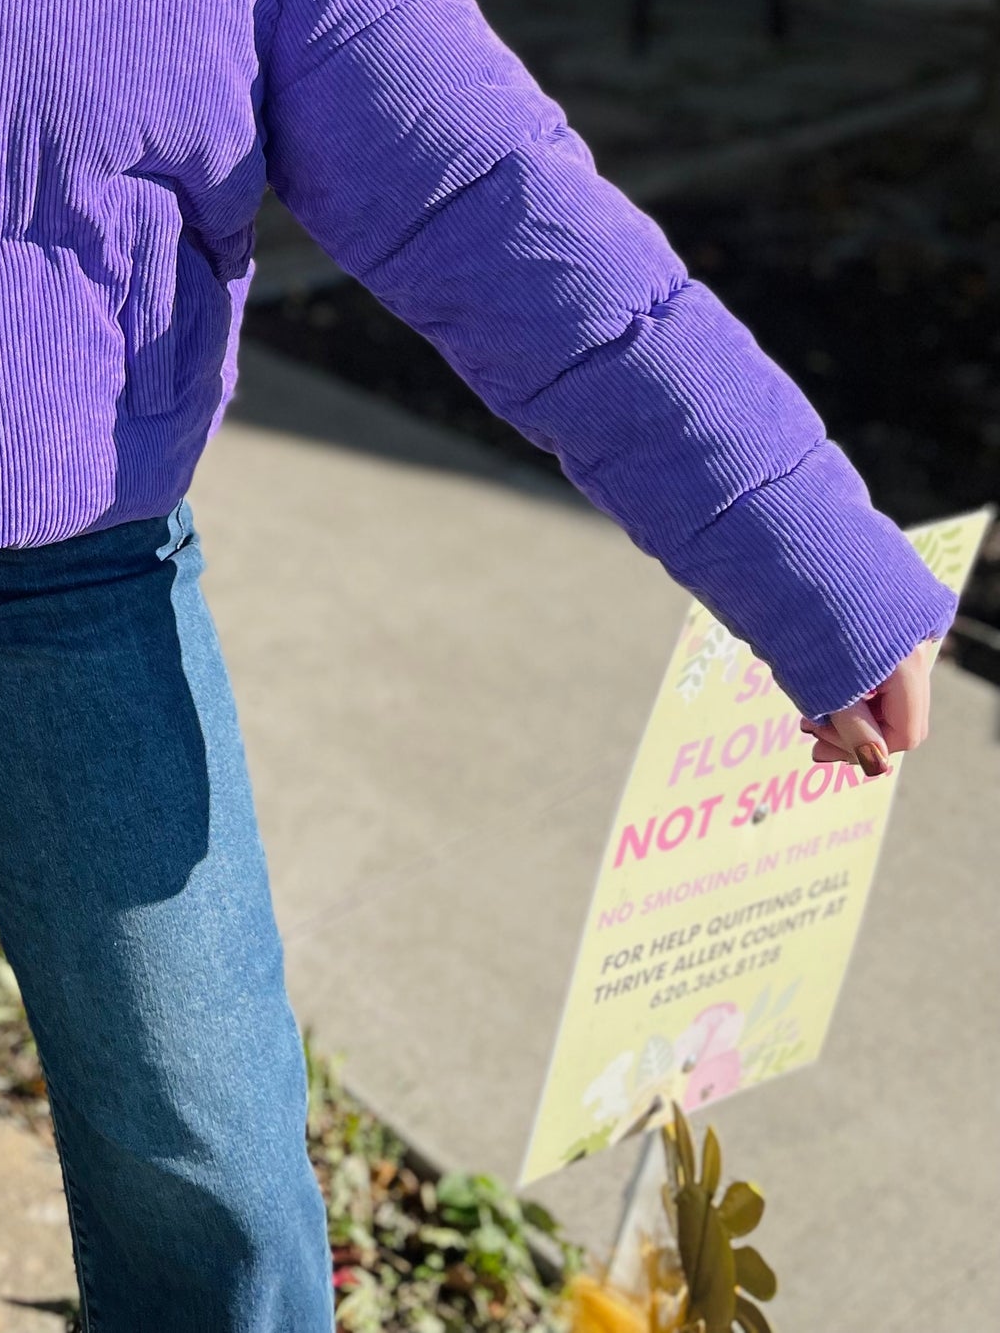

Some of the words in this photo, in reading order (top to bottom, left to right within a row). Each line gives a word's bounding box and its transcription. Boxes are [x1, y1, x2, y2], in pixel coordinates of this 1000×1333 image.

[668, 713, 815, 786] FLOW
[597, 903, 634, 929] NO
[640, 863, 748, 914] SMOKING
[754, 851, 779, 876] IN
[786, 835, 821, 863] THE
[826, 818, 875, 847] PARK
[612, 794, 723, 869] NOT
[593, 962, 668, 1004] THRIVE
[672, 937, 735, 974] ALLEN
[739, 905, 819, 949] COUNTY
[822, 896, 848, 920] AT
[600, 944, 644, 974] FOR
[649, 924, 701, 956] HELP
[706, 888, 802, 936] QUITTING
[807, 870, 850, 899] CALL
